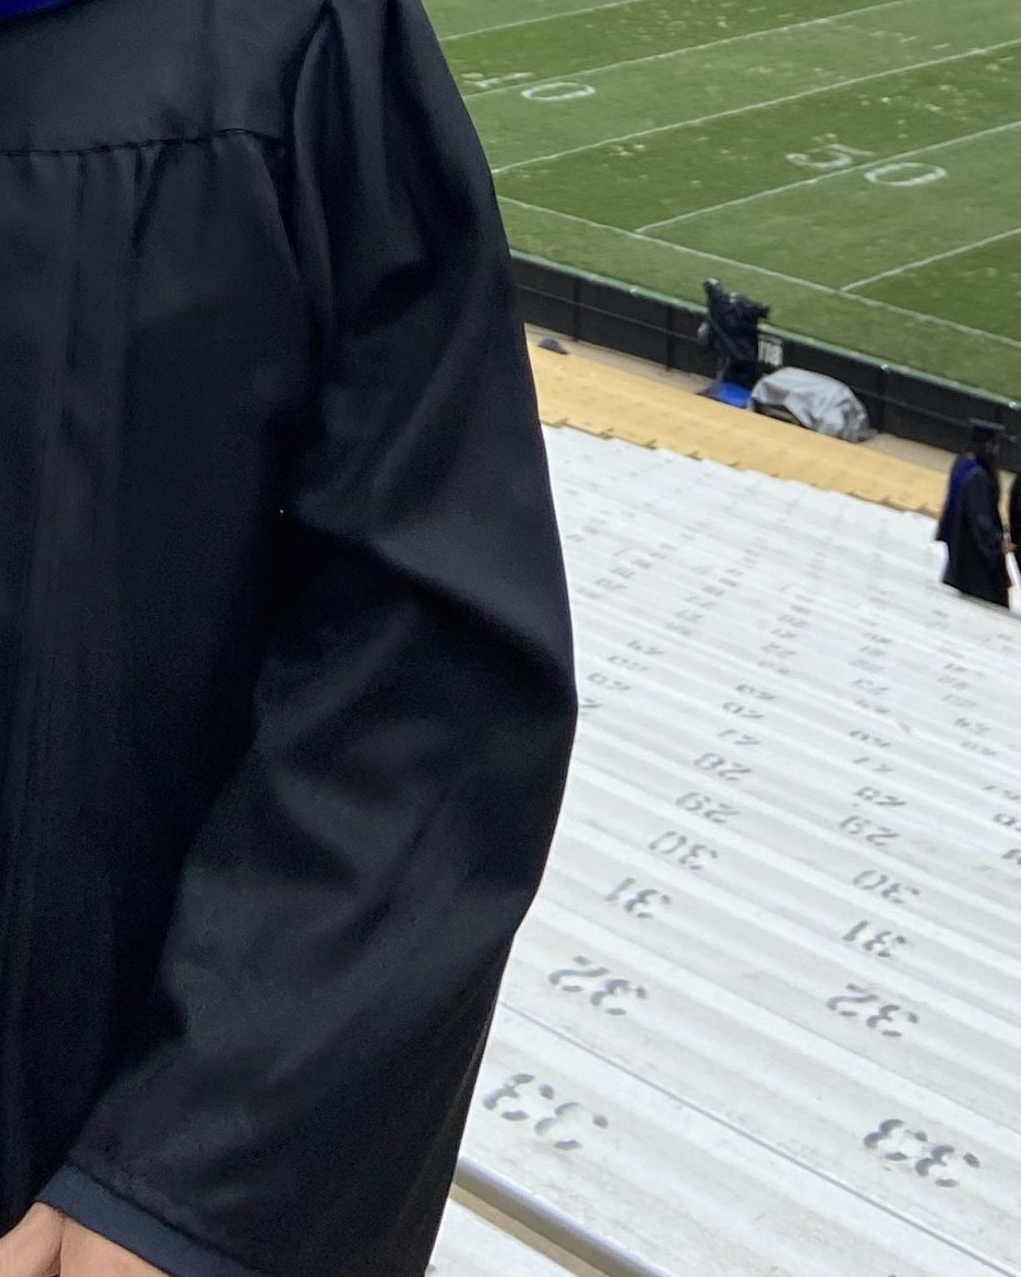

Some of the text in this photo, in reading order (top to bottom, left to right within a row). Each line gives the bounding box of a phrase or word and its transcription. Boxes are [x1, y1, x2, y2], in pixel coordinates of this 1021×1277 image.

[693, 751, 752, 782] 28
[674, 790, 741, 823] 29
[648, 830, 719, 871] 30
[838, 814, 902, 847] 29
[604, 876, 672, 919] 31
[852, 869, 921, 905] 30
[841, 919, 908, 958] 31
[548, 955, 649, 1016] 32
[826, 983, 920, 1038] 32
[482, 1072, 610, 1151] 33
[862, 1118, 981, 1189] 33
